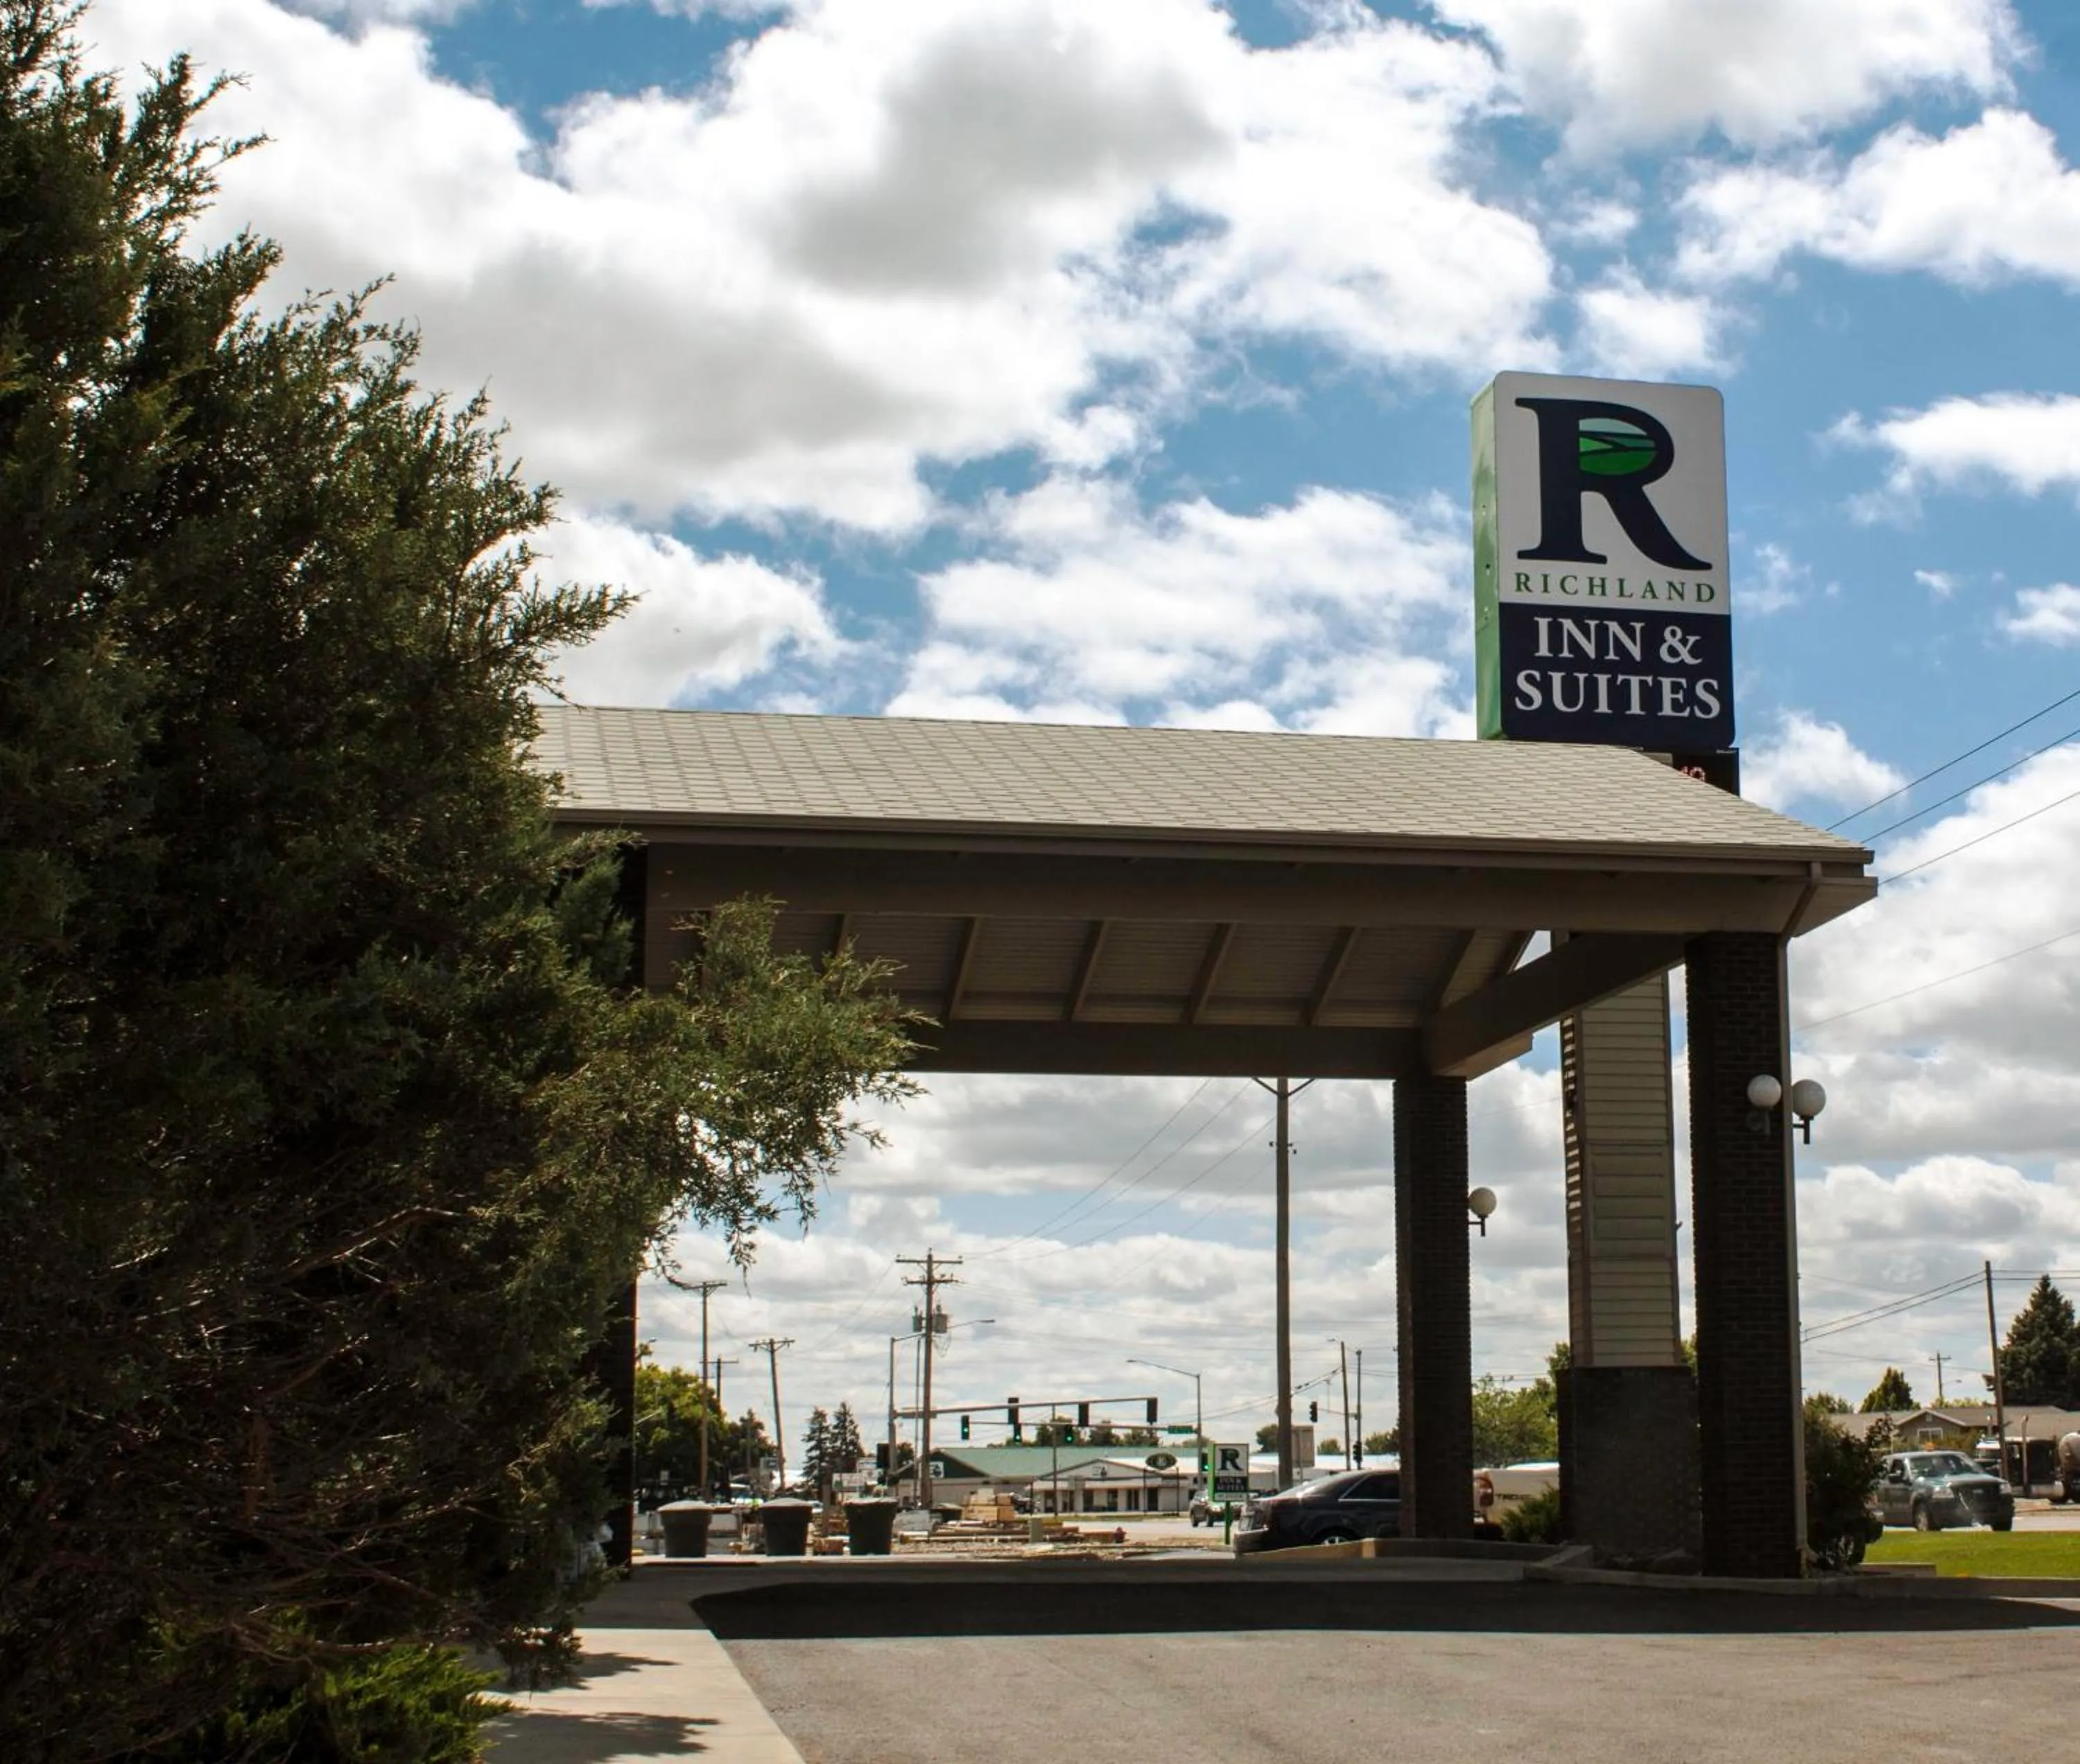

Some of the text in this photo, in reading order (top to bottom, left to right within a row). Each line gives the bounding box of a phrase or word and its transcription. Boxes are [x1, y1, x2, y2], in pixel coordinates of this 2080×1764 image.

[1515, 397, 1713, 571] R
[1515, 573, 1715, 602] RICHLAND
[1534, 617, 1702, 664] INN &
[1514, 670, 1721, 719] SUITES
[1217, 1448, 1243, 1471] R
